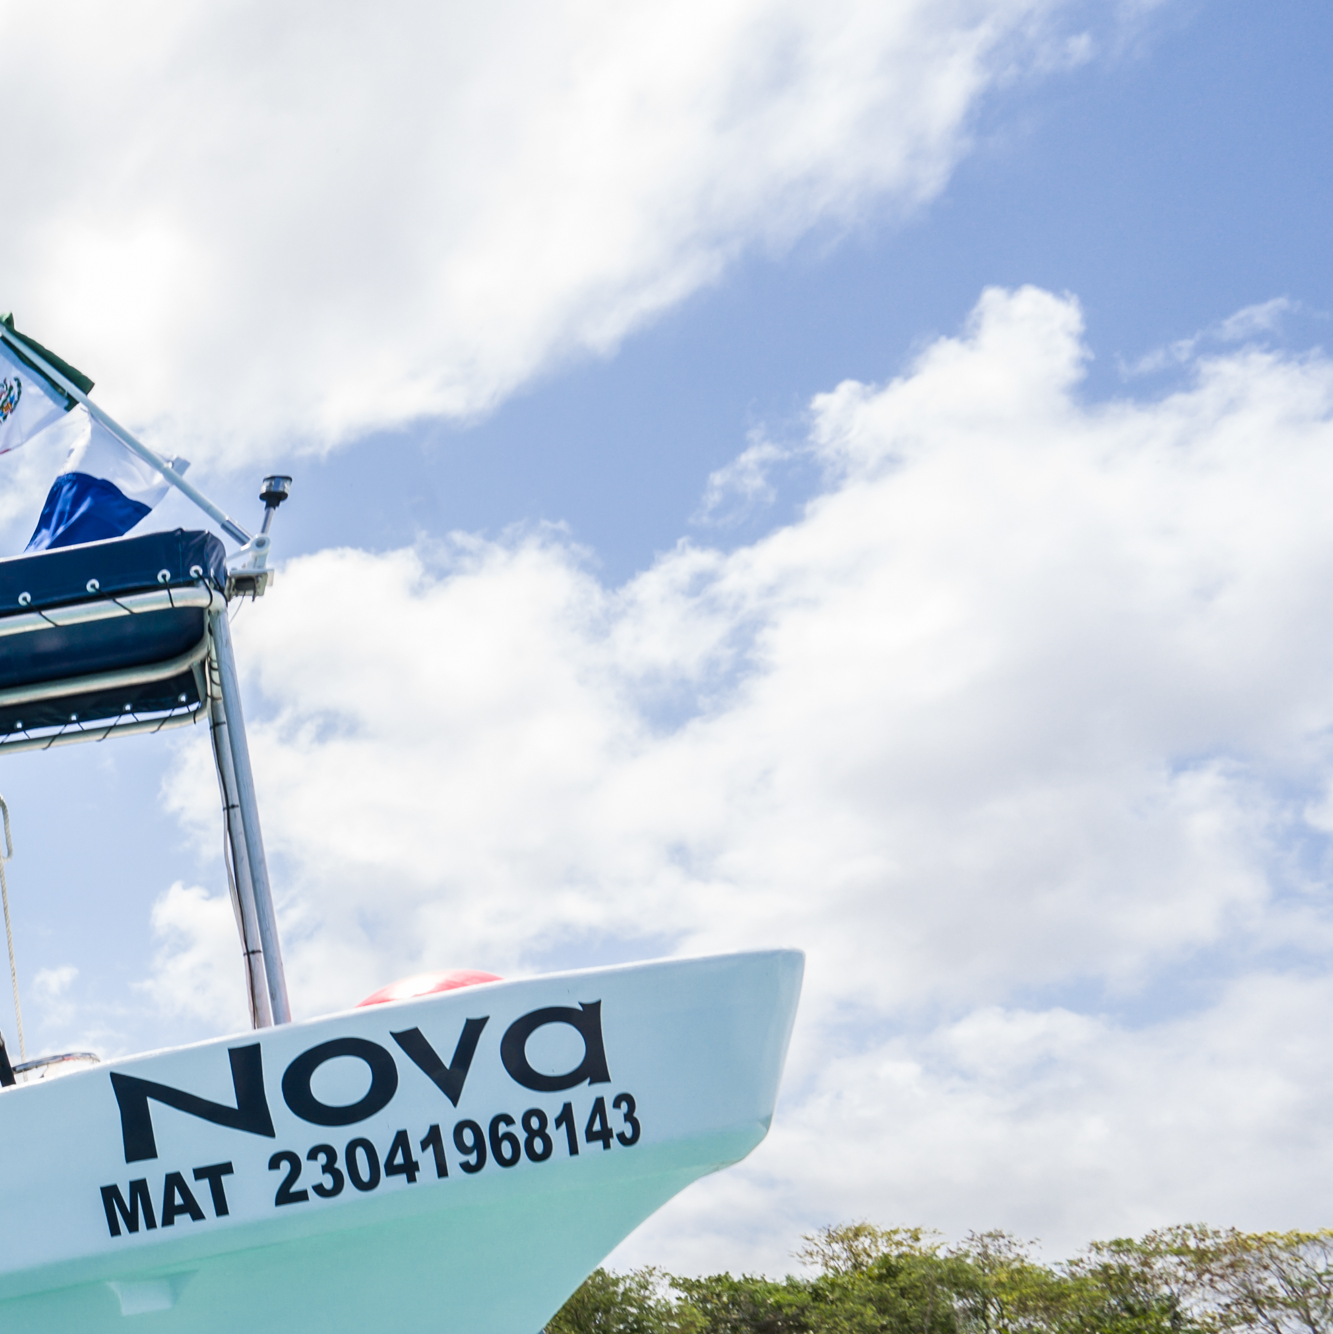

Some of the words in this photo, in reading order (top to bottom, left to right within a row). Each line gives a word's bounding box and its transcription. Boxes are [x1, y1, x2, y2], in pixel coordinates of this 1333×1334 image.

[109, 1000, 612, 1164] Nova
[99, 1161, 235, 1237] MAT
[267, 1092, 641, 1207] 23041968143
